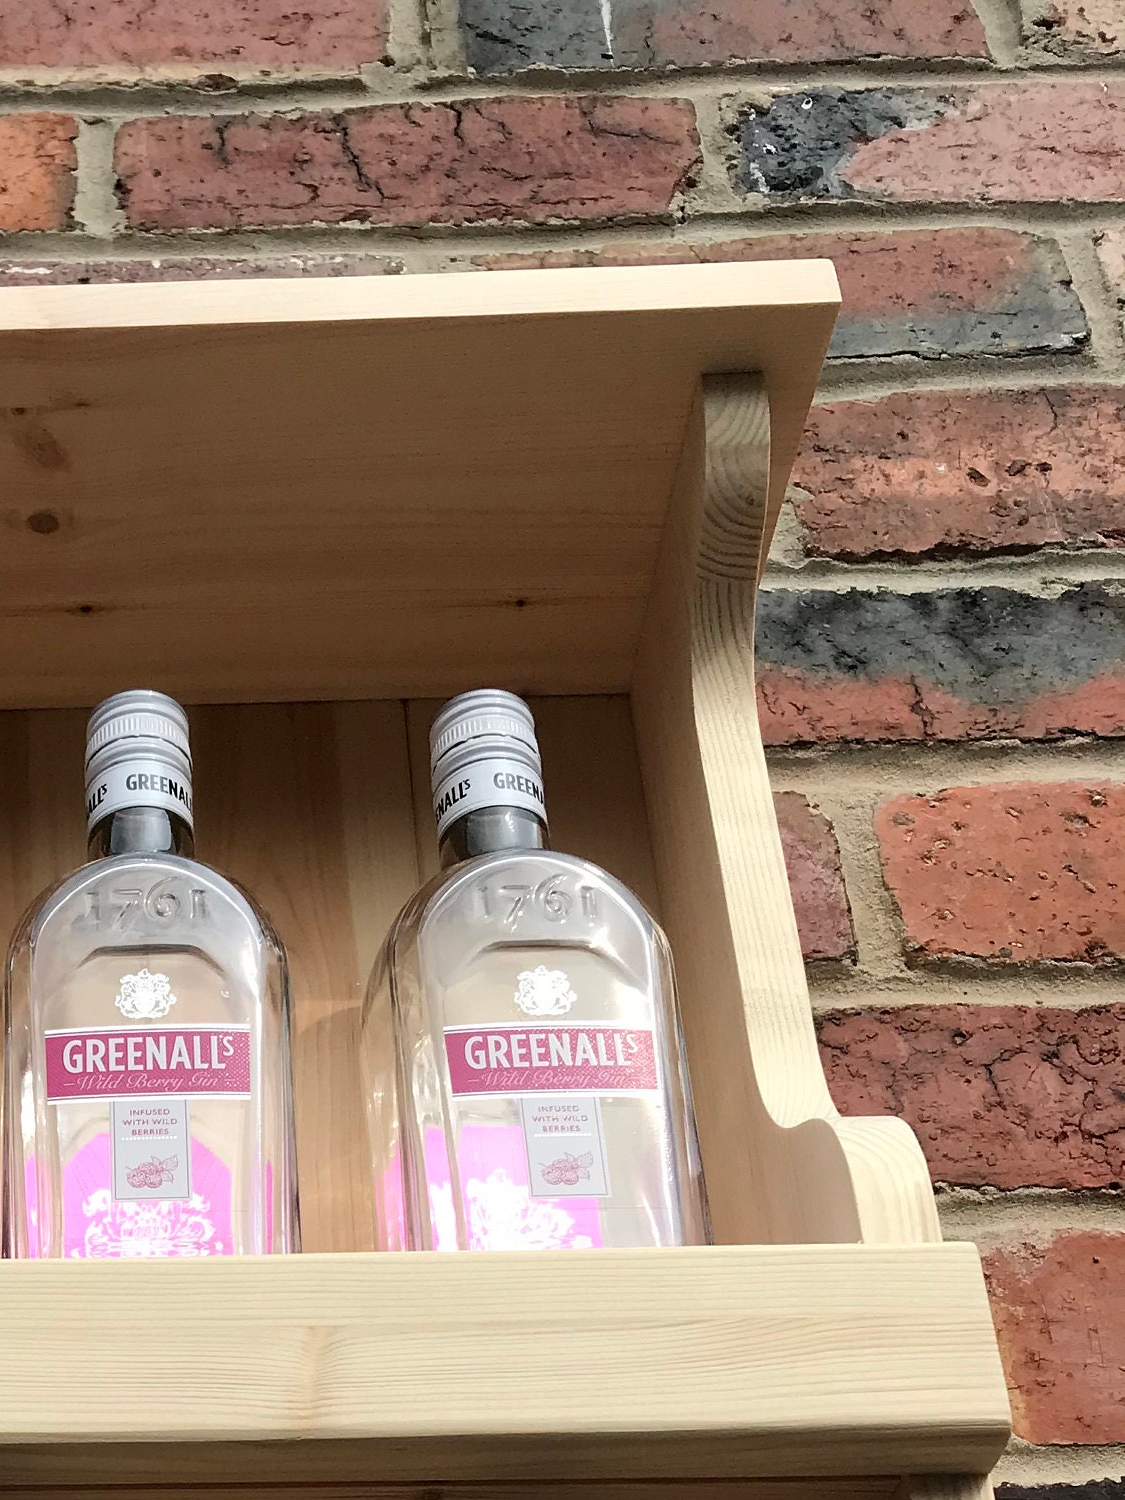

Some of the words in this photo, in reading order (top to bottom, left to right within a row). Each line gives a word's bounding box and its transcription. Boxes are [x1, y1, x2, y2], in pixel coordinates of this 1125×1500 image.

[85, 875, 206, 932] 1761
[477, 873, 597, 932] 1761
[62, 1035, 235, 1074] GREENALL'S
[76, 1074, 124, 1091] Wild
[125, 1072, 184, 1092] Berry
[188, 1072, 219, 1087] Gin
[481, 1069, 530, 1087] Wild
[532, 1068, 592, 1088] Berry
[594, 1068, 626, 1084] Gin
[122, 1118, 149, 1126] WITH
[129, 1108, 170, 1116] INFUSED
[562, 1114, 589, 1122] WILD
[131, 1128, 169, 1136] BERRIES
